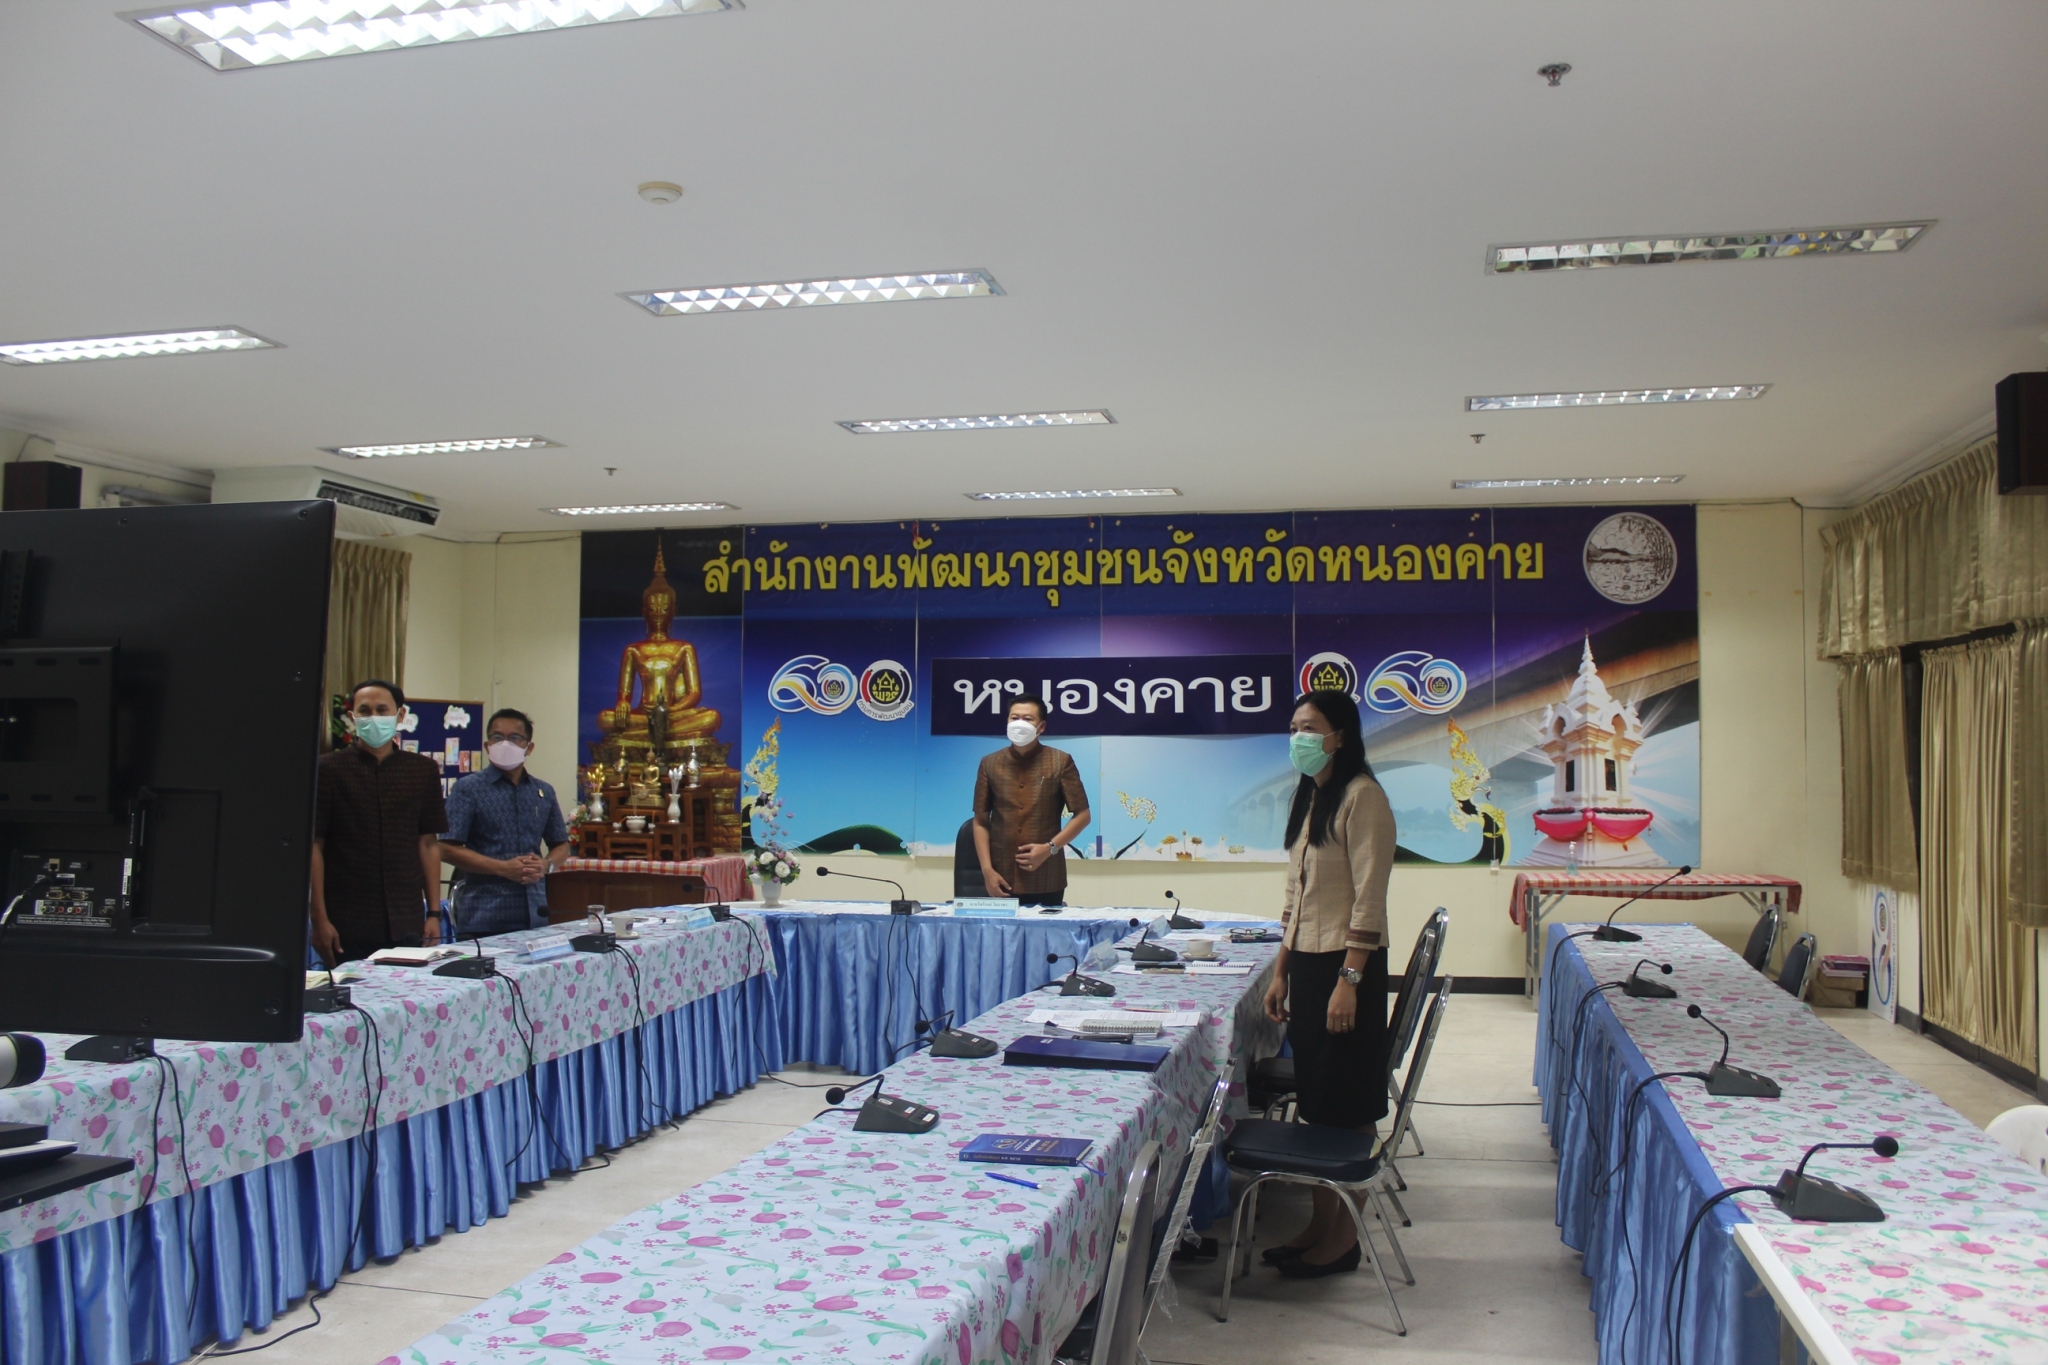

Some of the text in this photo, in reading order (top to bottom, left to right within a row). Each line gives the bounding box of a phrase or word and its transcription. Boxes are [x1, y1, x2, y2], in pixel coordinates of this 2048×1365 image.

[857, 699, 914, 720] กรมการพัฒนาชุมชน
